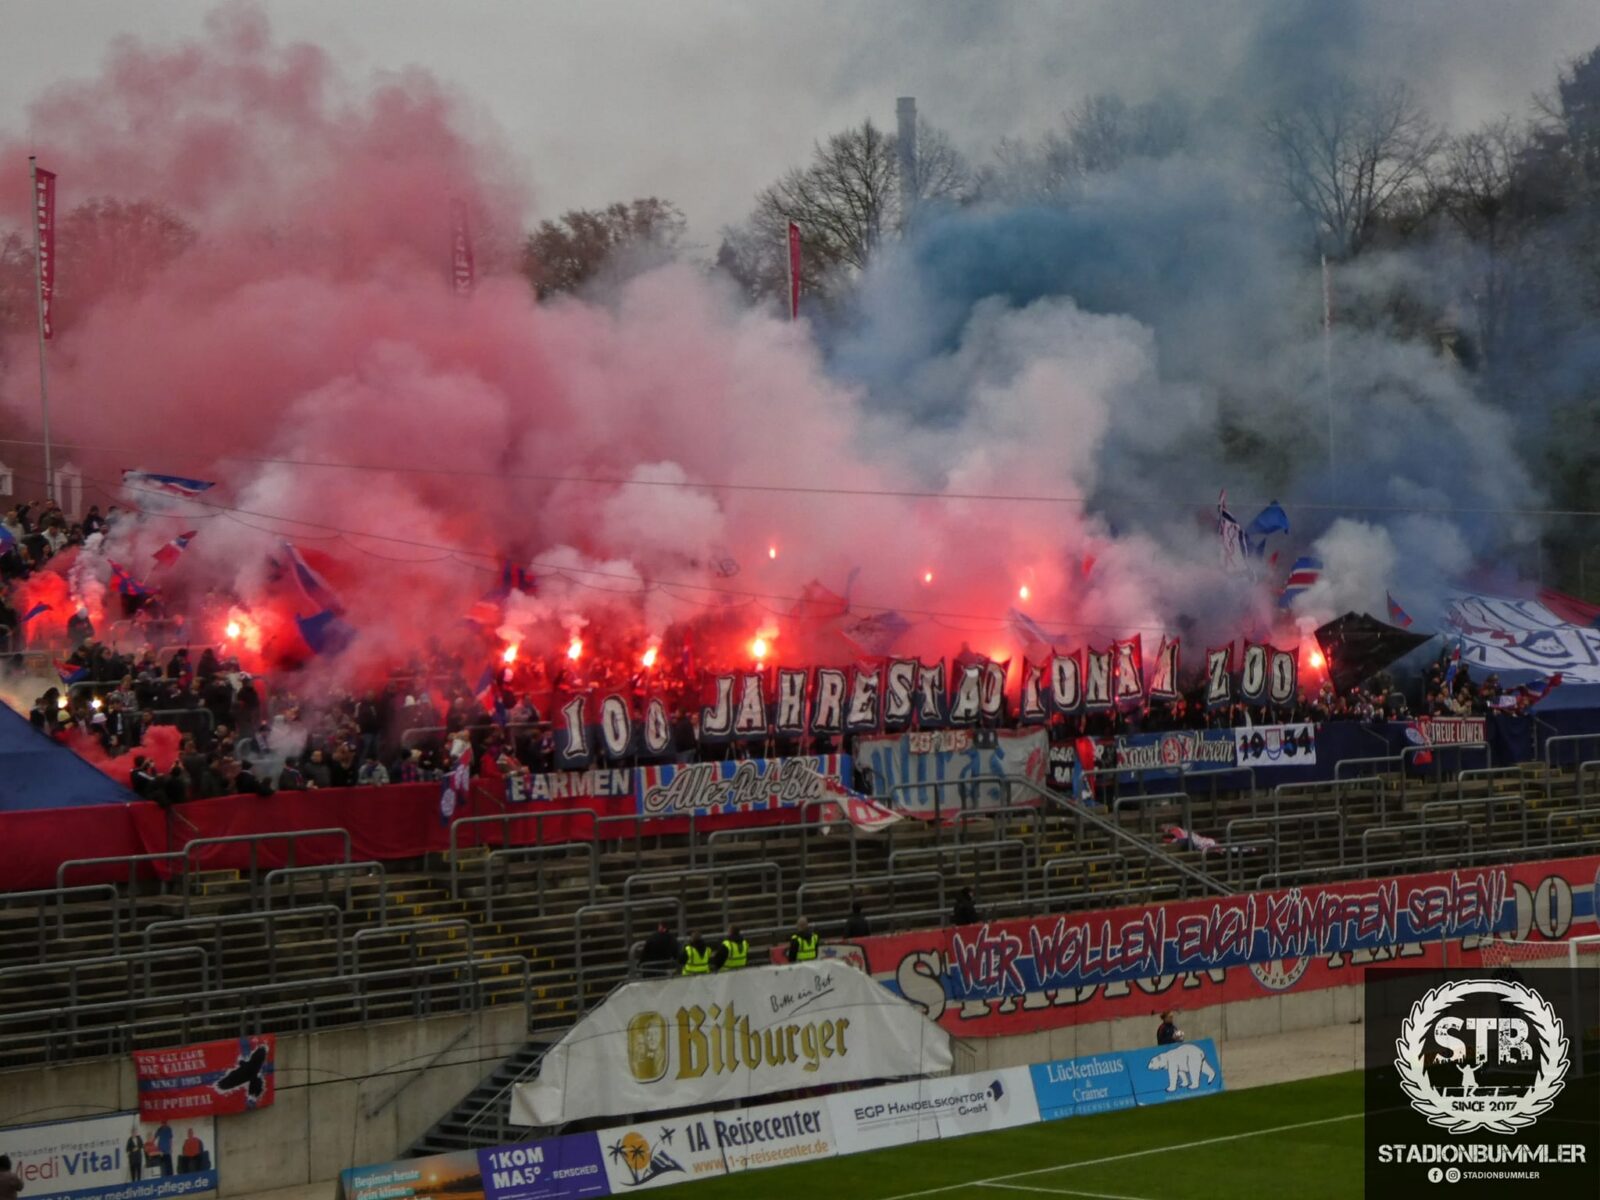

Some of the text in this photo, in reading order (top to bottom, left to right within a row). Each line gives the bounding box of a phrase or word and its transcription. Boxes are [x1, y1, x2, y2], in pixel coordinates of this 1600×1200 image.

[563, 694, 671, 758] 100
[702, 668, 880, 736] JAHRE
[1207, 645, 1296, 704] ZOO
[644, 764, 735, 812] Allez
[953, 924, 1025, 996] WIR
[1030, 907, 1166, 986] WOLLEN
[1174, 895, 1256, 965] EUCH
[1265, 881, 1398, 958] KÄMPFEN
[675, 1001, 850, 1079] Bitburger
[1047, 1057, 1124, 1083] Lückenhaus
[143, 1093, 213, 1111] WUPPERTAL
[854, 1104, 885, 1120] EGP
[887, 1092, 984, 1115] HANDELSKONTOR
[1072, 1087, 1108, 1102] Cramer
[685, 1121, 710, 1153] 1A
[714, 1110, 821, 1148] Reisecenter
[62, 1148, 120, 1176] Vital
[553, 1164, 599, 1179] REMSCHEID
[692, 1138, 829, 1174] www1-a-reisecenter.de
